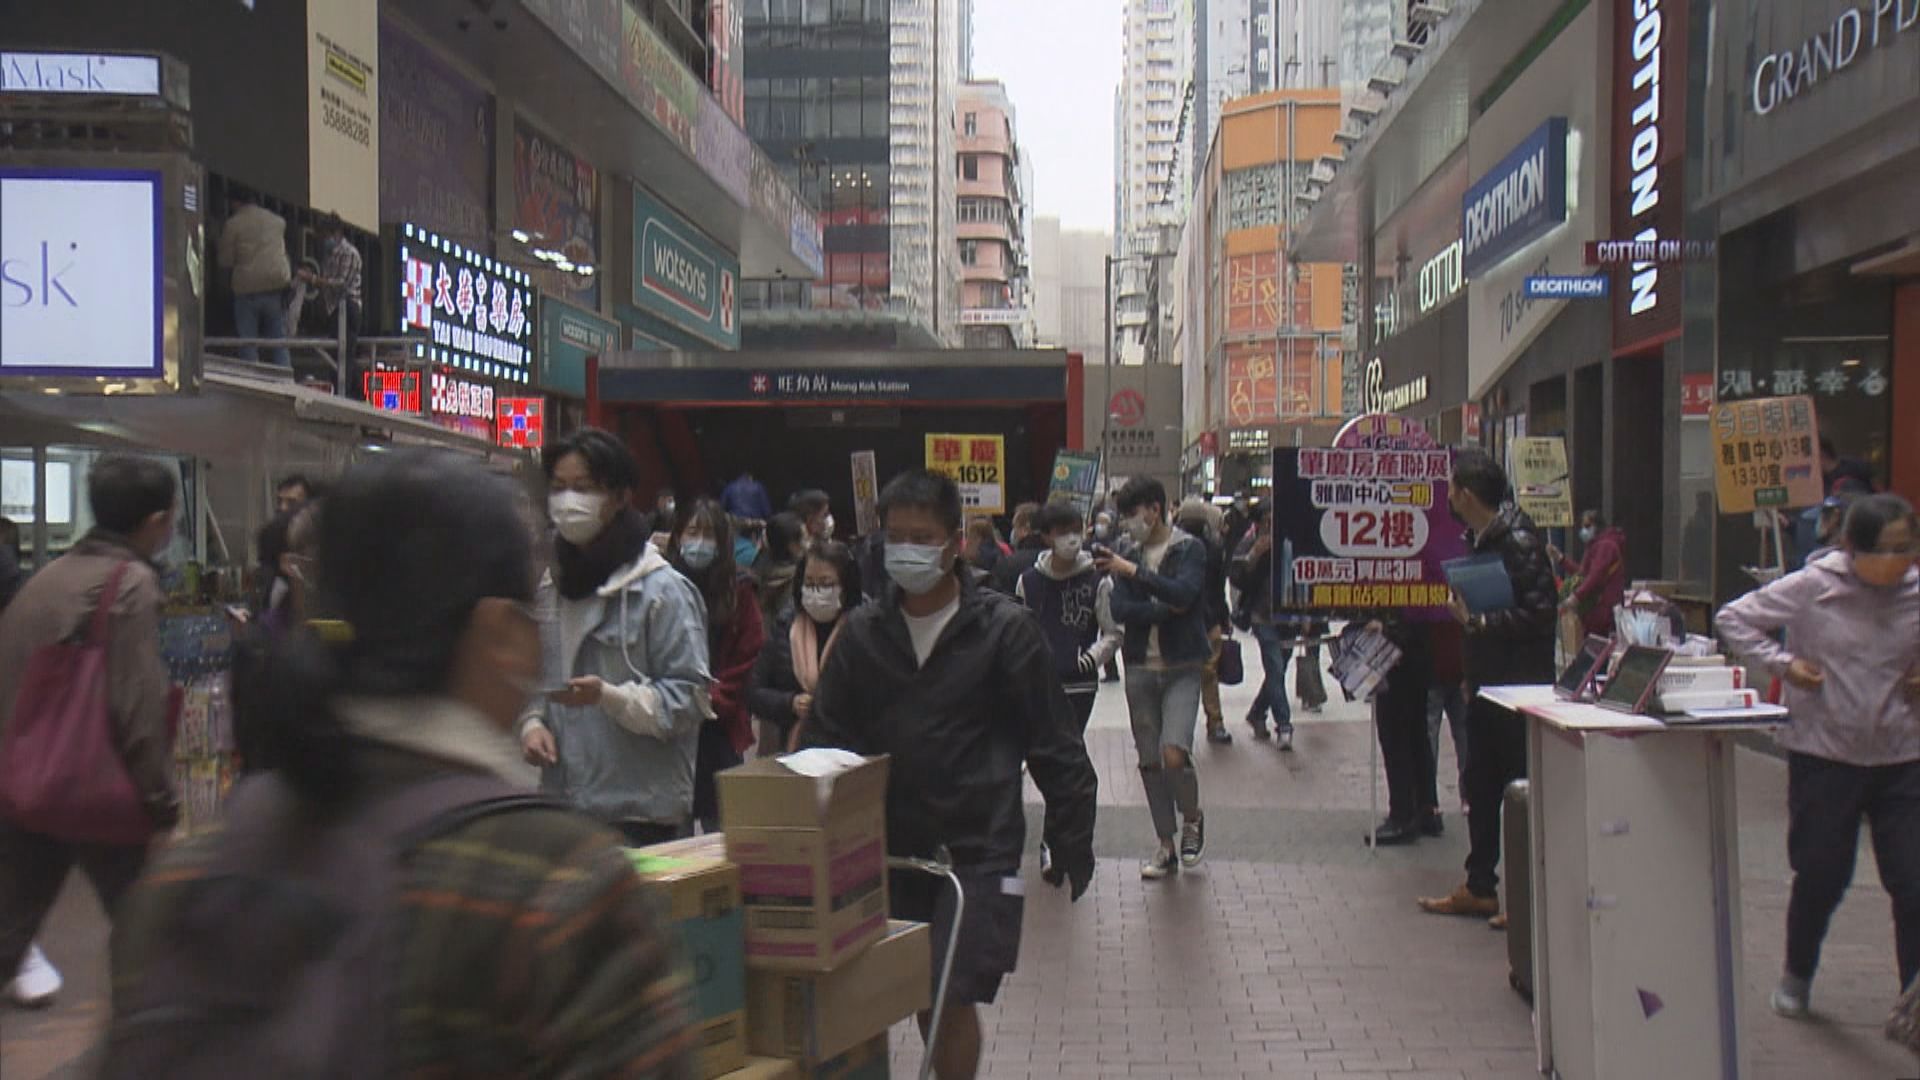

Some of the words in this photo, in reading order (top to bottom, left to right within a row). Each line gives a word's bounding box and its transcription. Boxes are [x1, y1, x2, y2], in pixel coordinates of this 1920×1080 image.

[1753, 8, 1861, 115] GRAND
[1872, 0, 1920, 46] PL
[1466, 148, 1544, 255] DECATHLON
[1597, 241, 1656, 261] COTTON
[1659, 241, 1680, 261] ON
[653, 240, 706, 301] watsons
[1530, 279, 1602, 293] DECATHLON
[778, 373, 828, 393] 旺角站
[957, 466, 998, 483] 1612
[1334, 510, 1415, 548] 12樓
